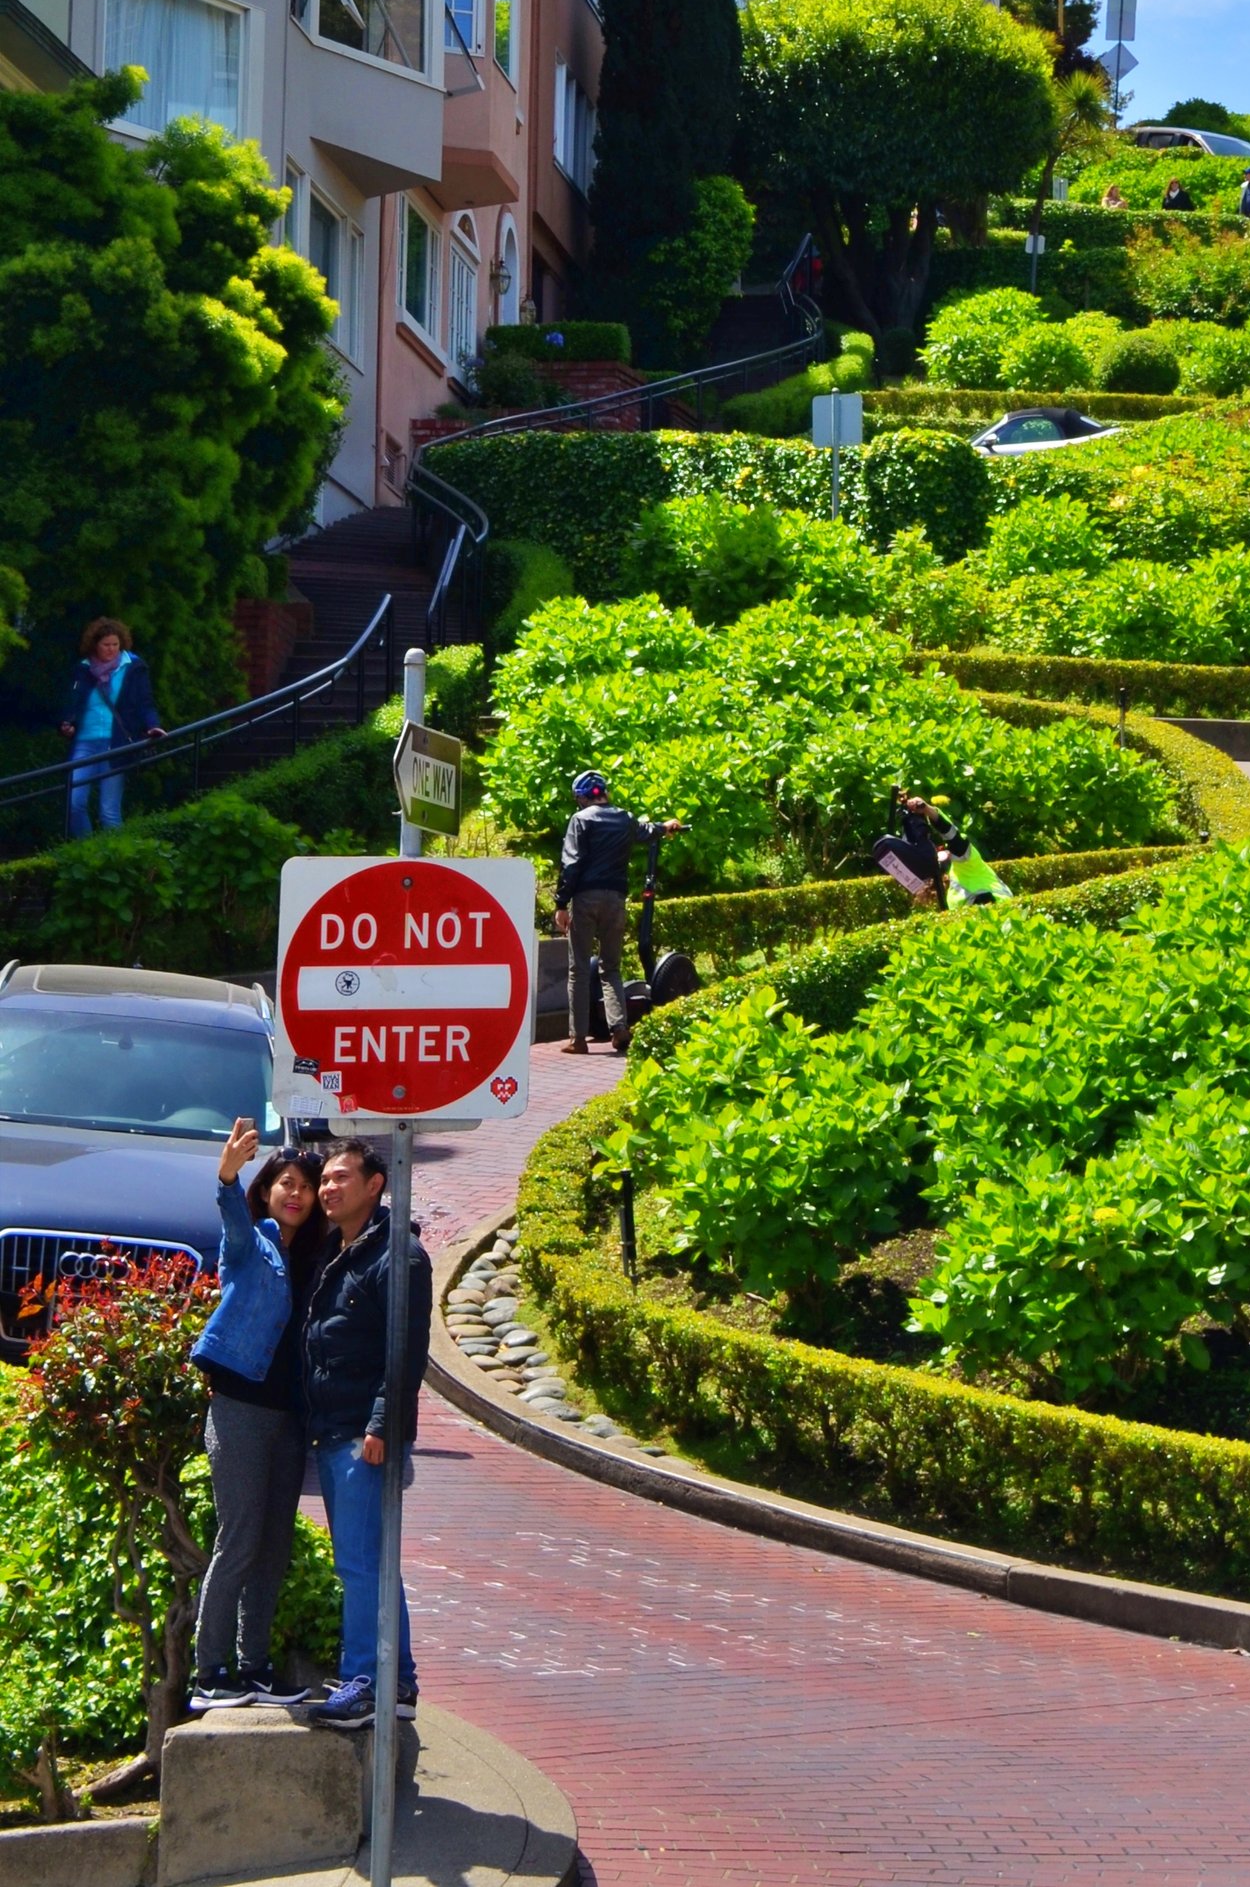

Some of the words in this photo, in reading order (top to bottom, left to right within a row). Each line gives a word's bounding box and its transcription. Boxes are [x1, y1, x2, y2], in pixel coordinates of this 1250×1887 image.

[412, 757, 430, 797] ONE
[432, 764, 453, 803] WAY
[320, 913, 378, 951] DO
[404, 912, 490, 949] NOT
[334, 1025, 471, 1063] ENTER
